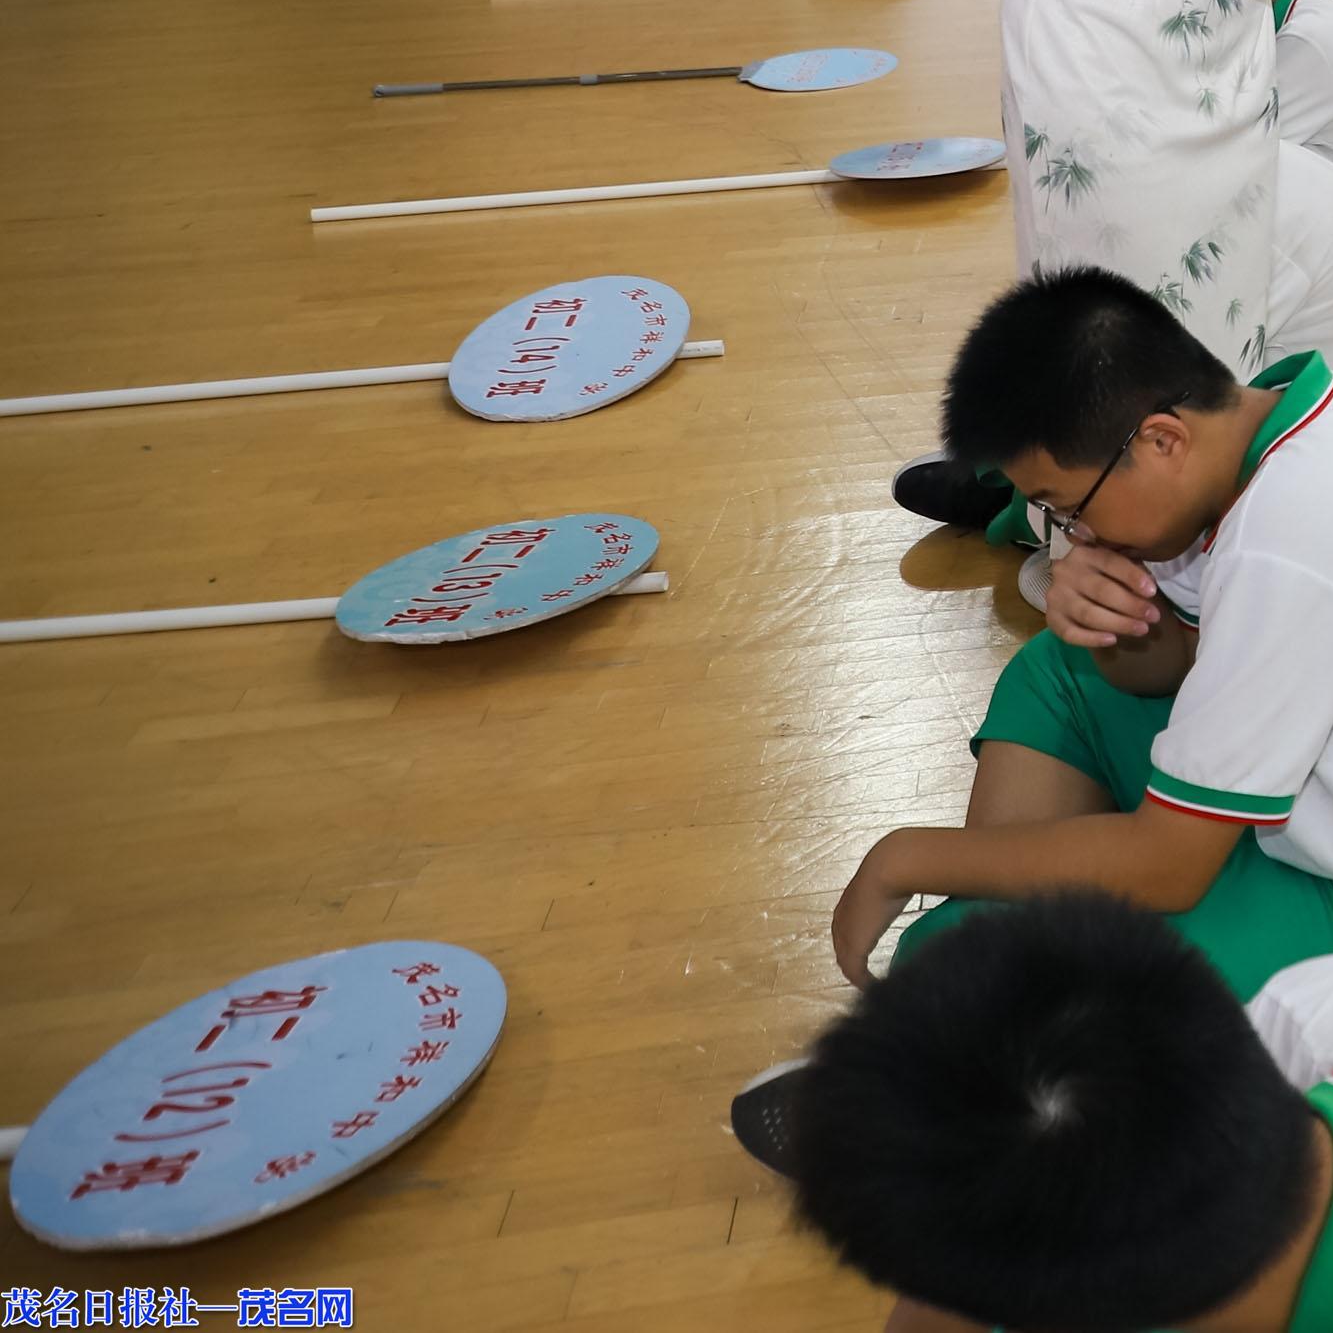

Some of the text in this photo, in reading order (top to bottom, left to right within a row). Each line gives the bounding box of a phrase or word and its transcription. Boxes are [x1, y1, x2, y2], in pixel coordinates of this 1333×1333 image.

[486, 296, 589, 399] 初二(14)班
[384, 526, 557, 627] 初二(13)班
[69, 984, 330, 1202] 初二(12)班
